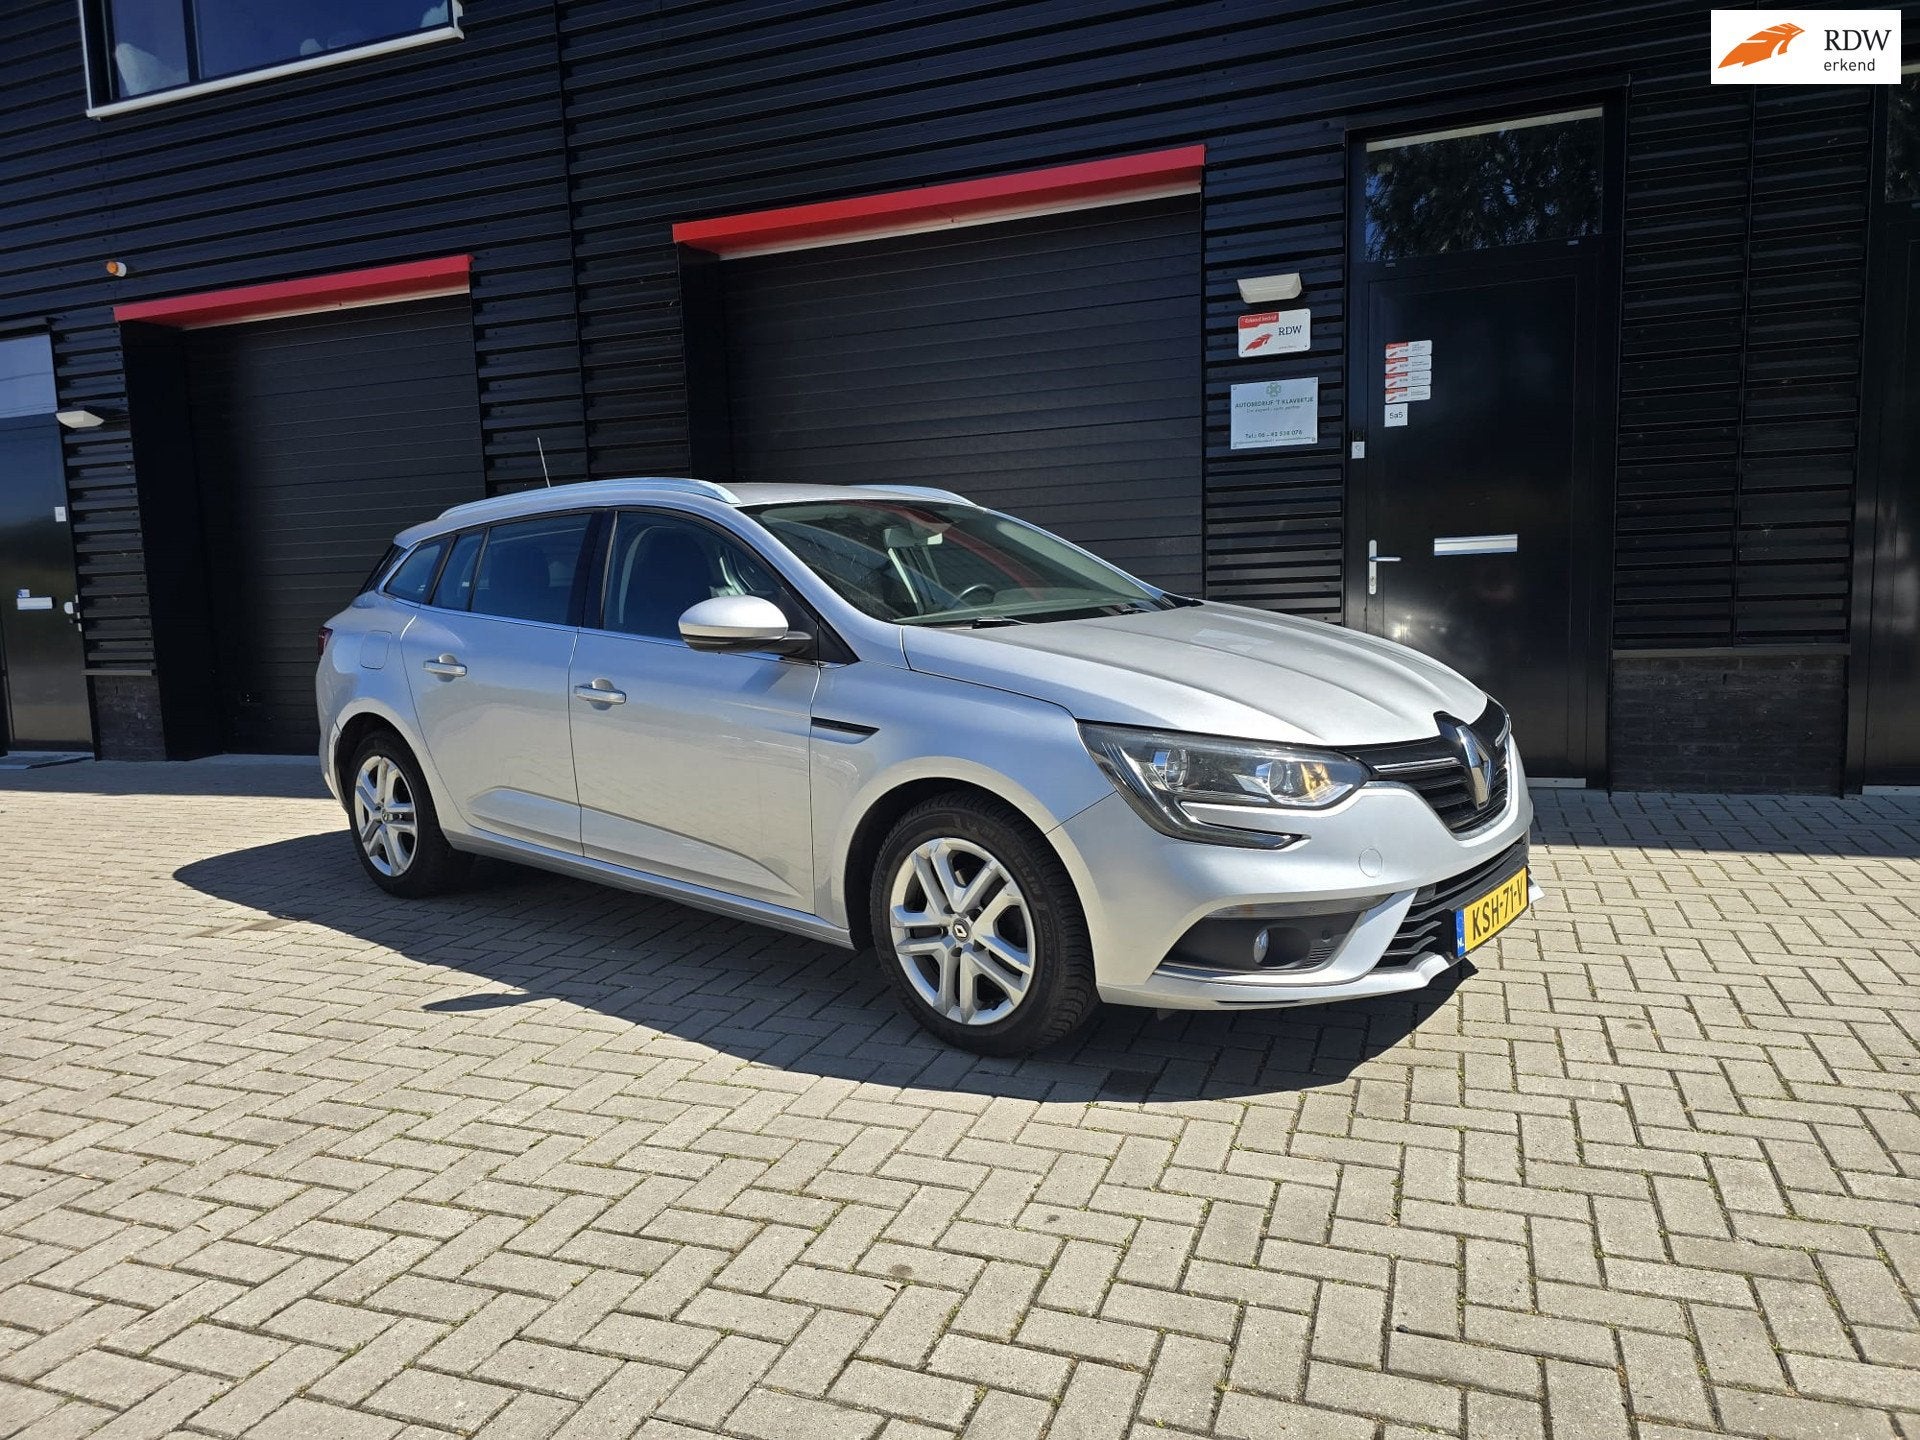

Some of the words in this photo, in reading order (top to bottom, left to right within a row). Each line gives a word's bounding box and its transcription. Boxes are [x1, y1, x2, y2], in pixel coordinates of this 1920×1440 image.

[1278, 325, 1302, 335] RDW
[1235, 399, 1274, 408] AUTOBEDRIJF
[1389, 411, 1403, 419] 5a5
[1472, 876, 1524, 941] KSH-71-V
[1457, 937, 1465, 947] NL
